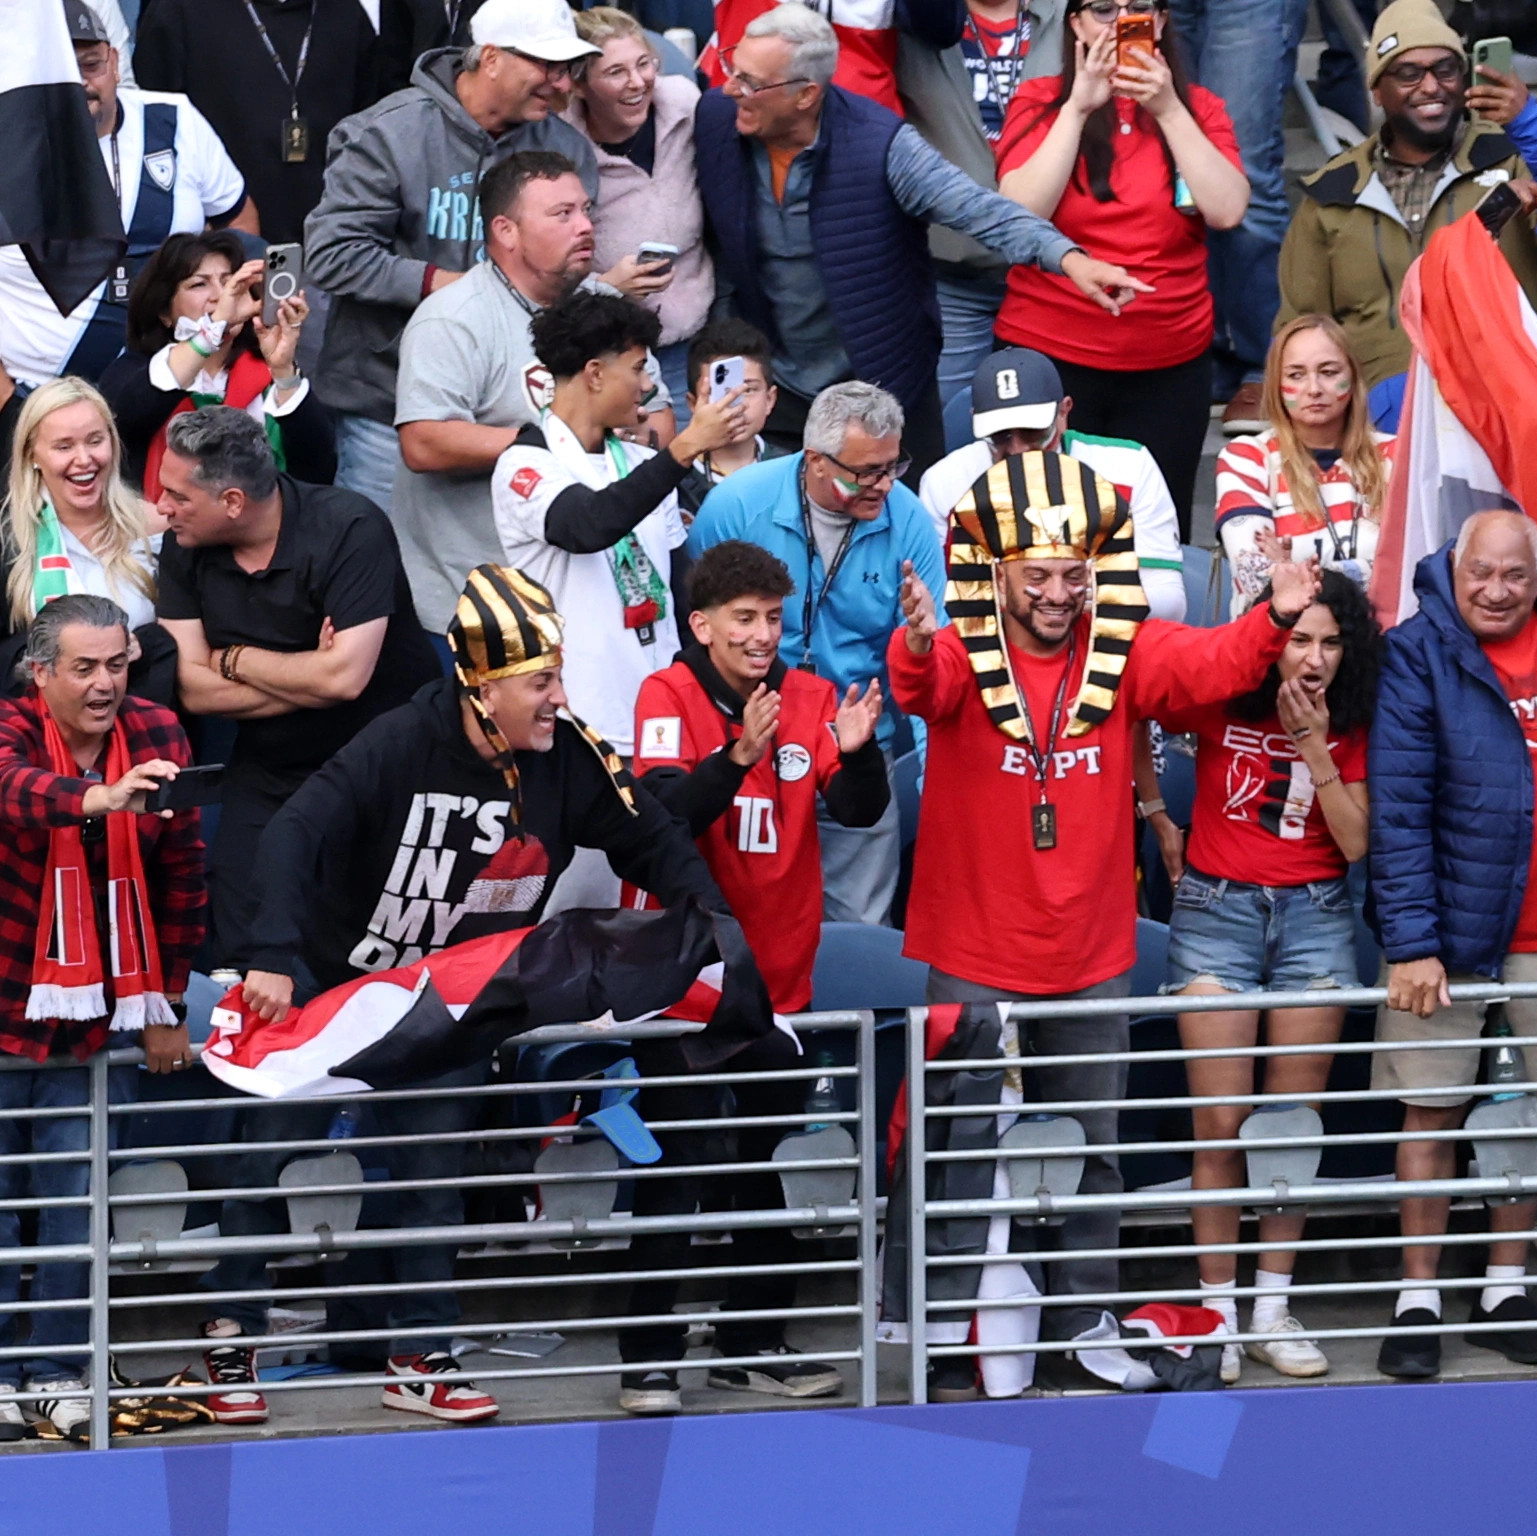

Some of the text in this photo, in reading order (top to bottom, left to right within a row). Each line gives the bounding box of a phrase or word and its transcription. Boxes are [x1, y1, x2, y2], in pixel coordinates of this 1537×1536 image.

[401, 792, 512, 855] IT'S
[733, 795, 778, 854] 10
[384, 845, 458, 900] IN
[367, 891, 470, 946] MY
